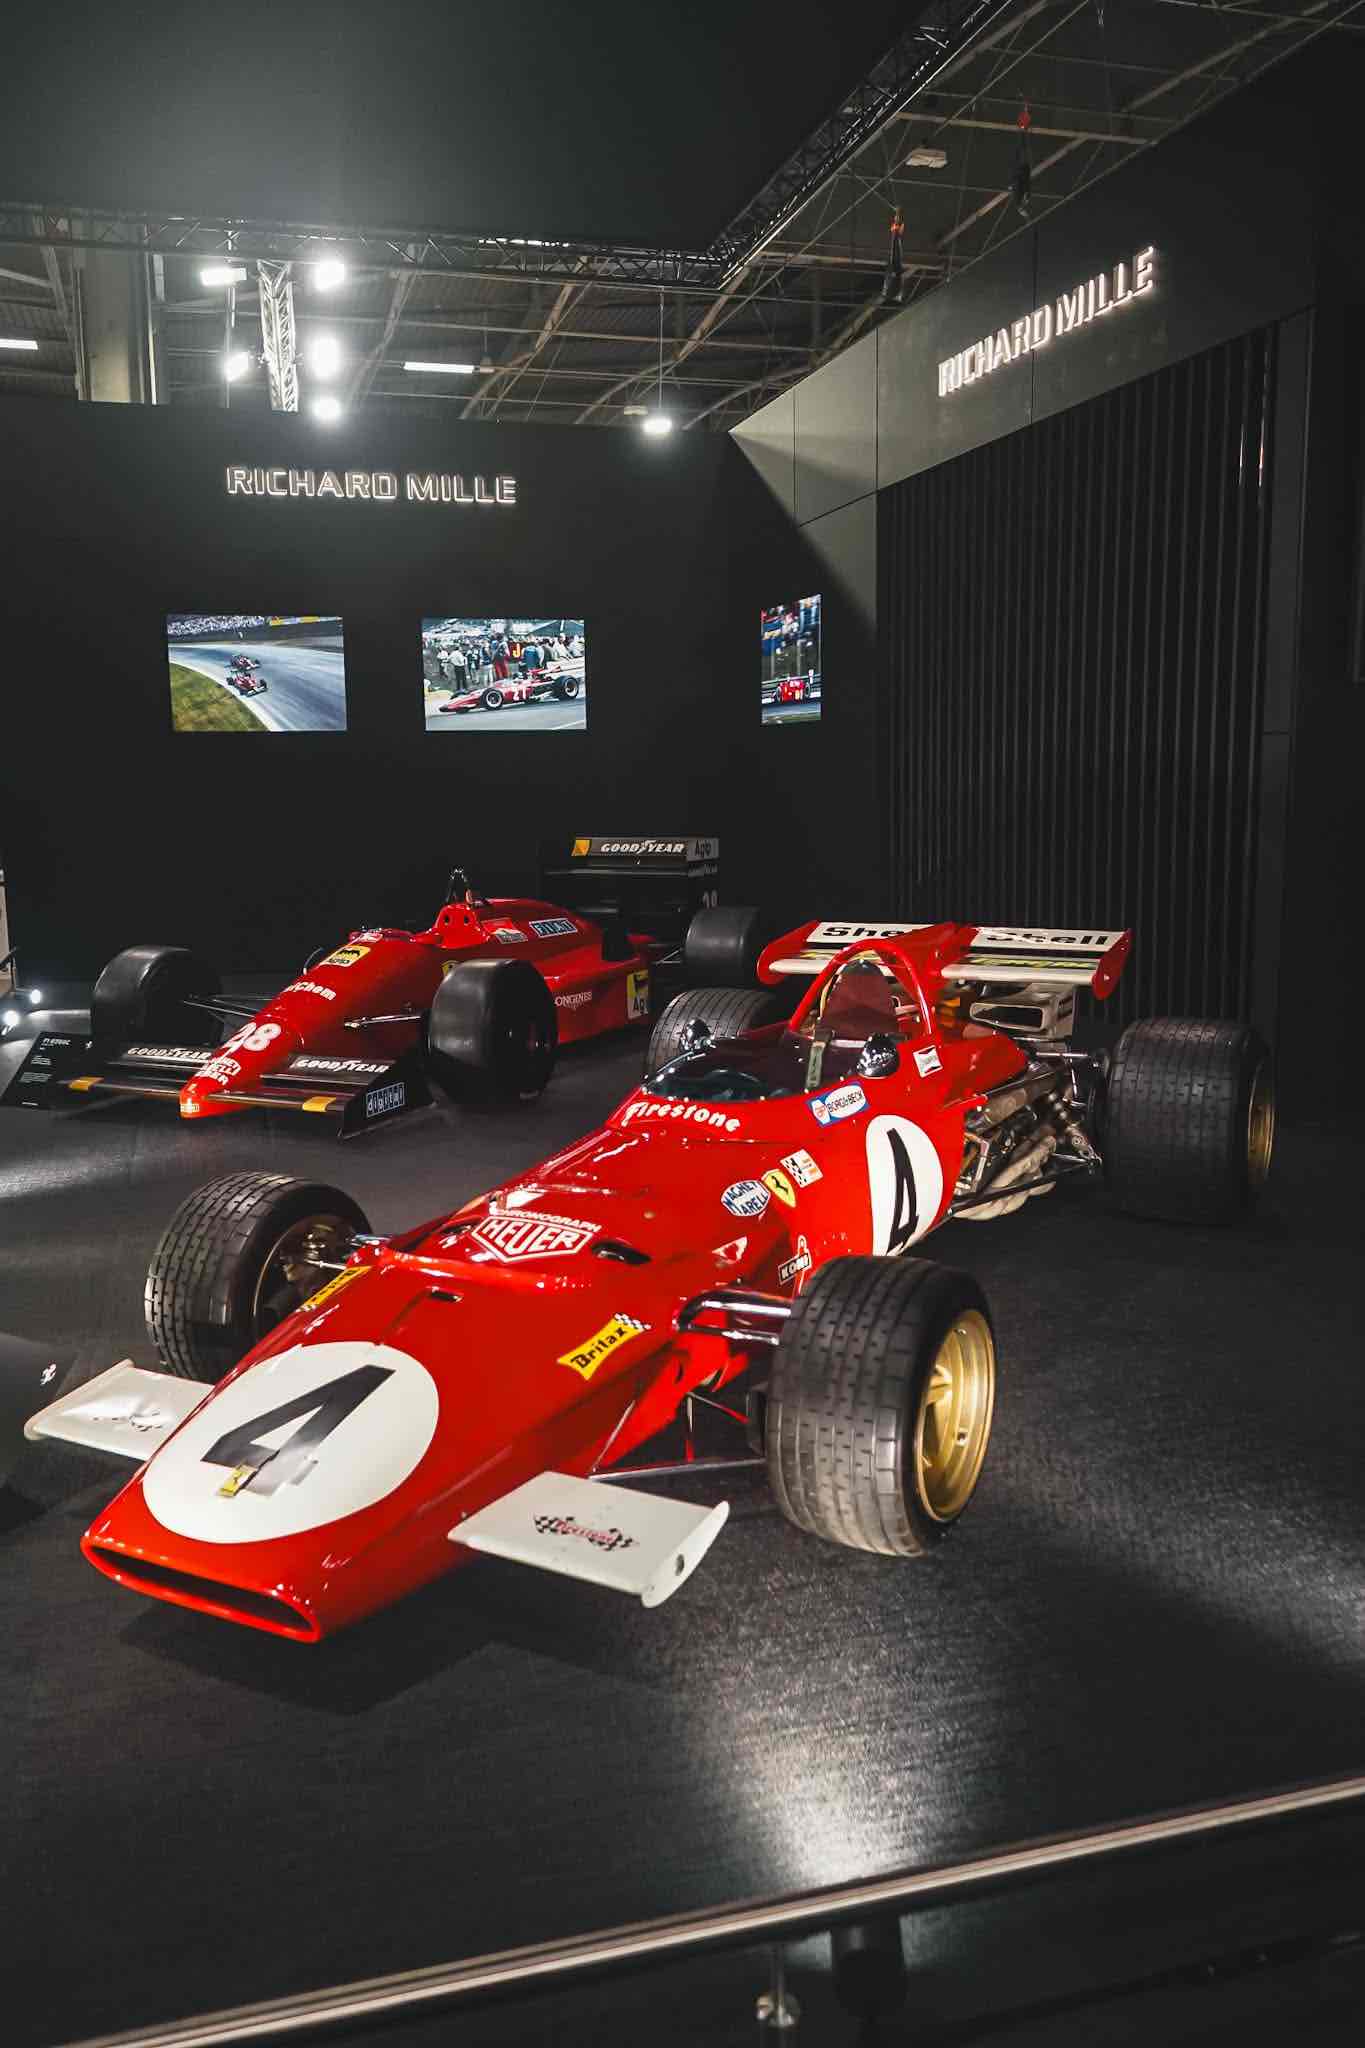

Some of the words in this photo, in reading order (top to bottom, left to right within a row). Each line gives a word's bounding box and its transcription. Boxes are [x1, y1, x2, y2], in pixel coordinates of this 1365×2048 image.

[937, 304, 1050, 397] RICHARD
[1055, 246, 1153, 336] MILLE
[227, 466, 397, 500] RICHARD
[406, 473, 517, 503] MILLE
[601, 839, 685, 854] GOODYEAR
[822, 925, 905, 938] She
[554, 991, 593, 1008] ONGINES
[222, 1021, 282, 1051] 28
[127, 1046, 213, 1061] GOODYEAR
[295, 1058, 390, 1073] GOODYEAR
[886, 1127, 919, 1256] 4
[481, 1219, 581, 1255] HEUER
[570, 1327, 628, 1368] Britax
[200, 1364, 397, 1497] 4
